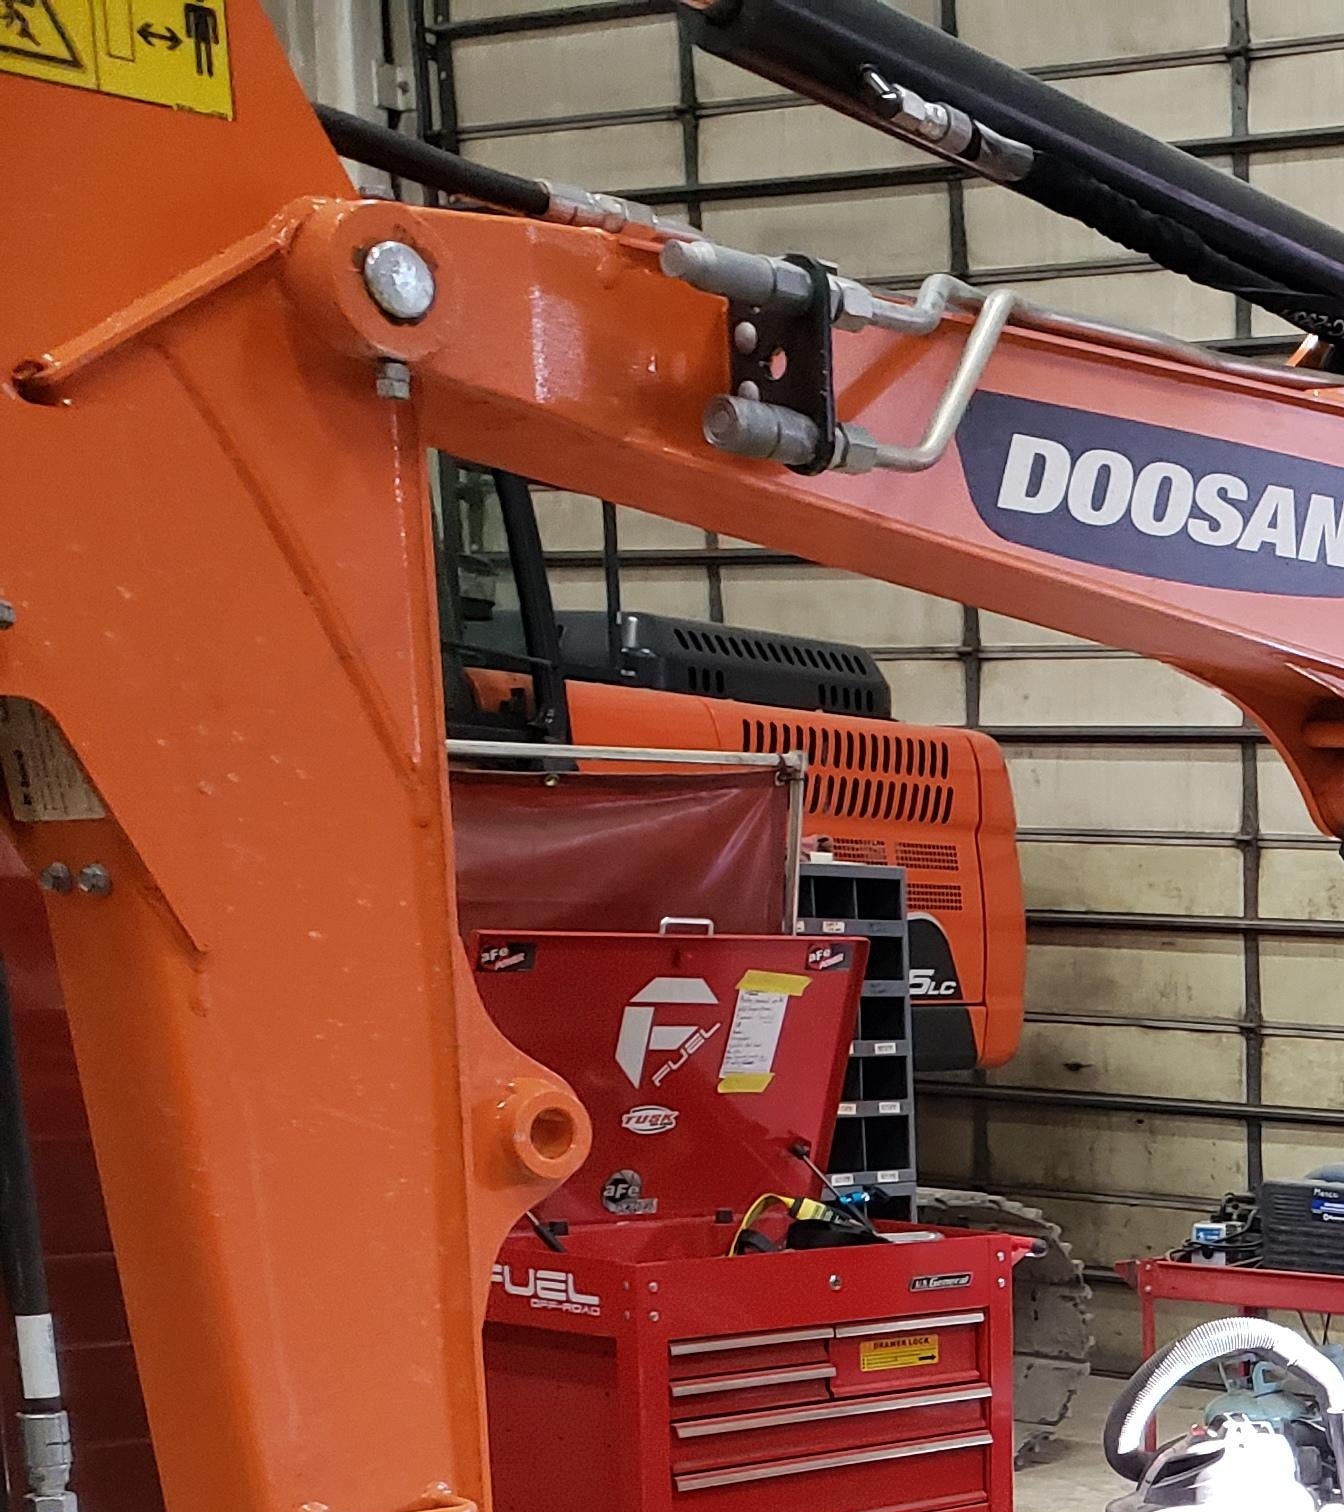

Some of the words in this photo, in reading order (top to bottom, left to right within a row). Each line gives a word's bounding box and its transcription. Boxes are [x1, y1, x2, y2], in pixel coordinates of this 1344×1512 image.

[651, 1022, 721, 1087] FUEL
[603, 1183, 640, 1199] aFe
[873, 1340, 907, 1350] DRAWER
[908, 1337, 930, 1347] LOCK
